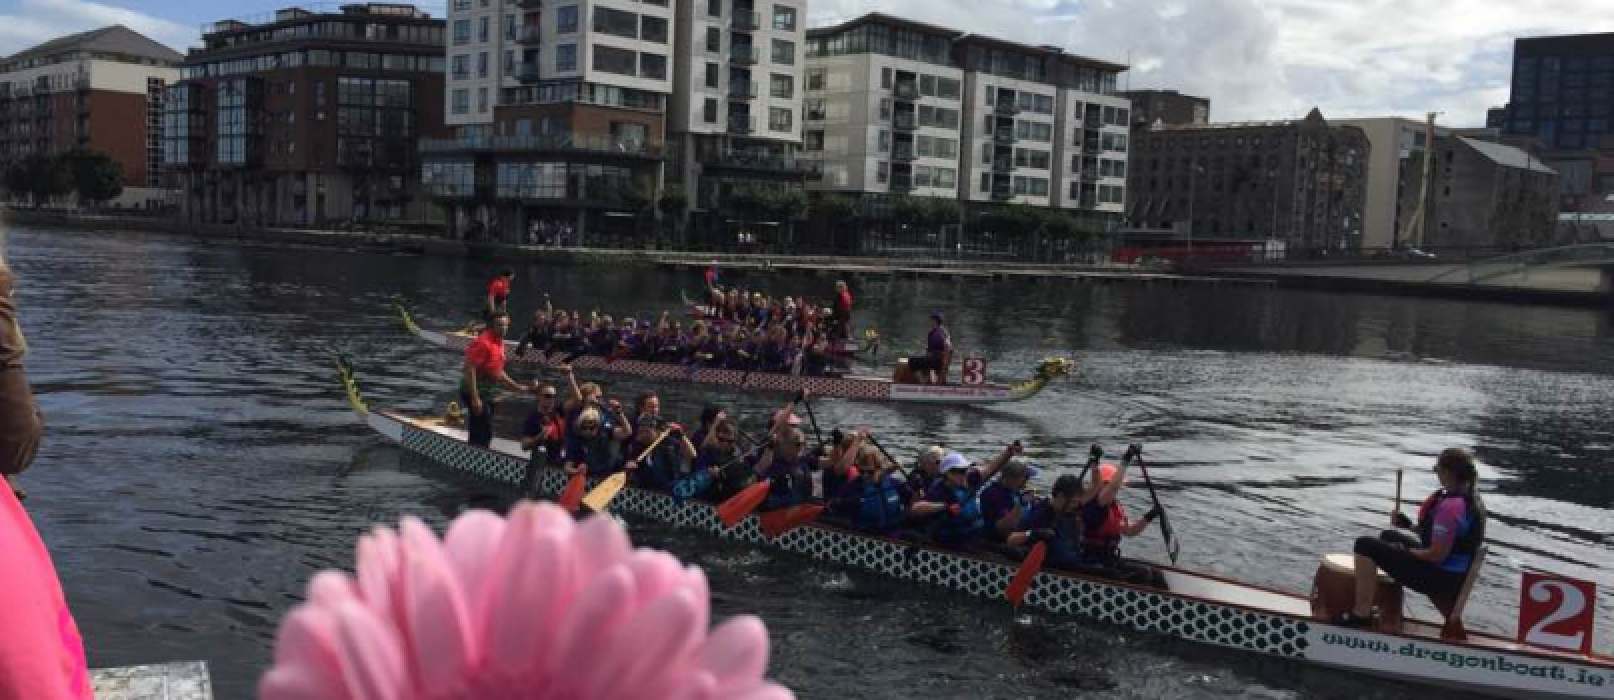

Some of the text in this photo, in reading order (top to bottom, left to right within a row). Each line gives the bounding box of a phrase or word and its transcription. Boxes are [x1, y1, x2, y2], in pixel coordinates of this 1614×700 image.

[964, 359, 983, 384] 3
[1525, 580, 1586, 650] 2
[1322, 633, 1604, 686] www.dragonboat.ie
